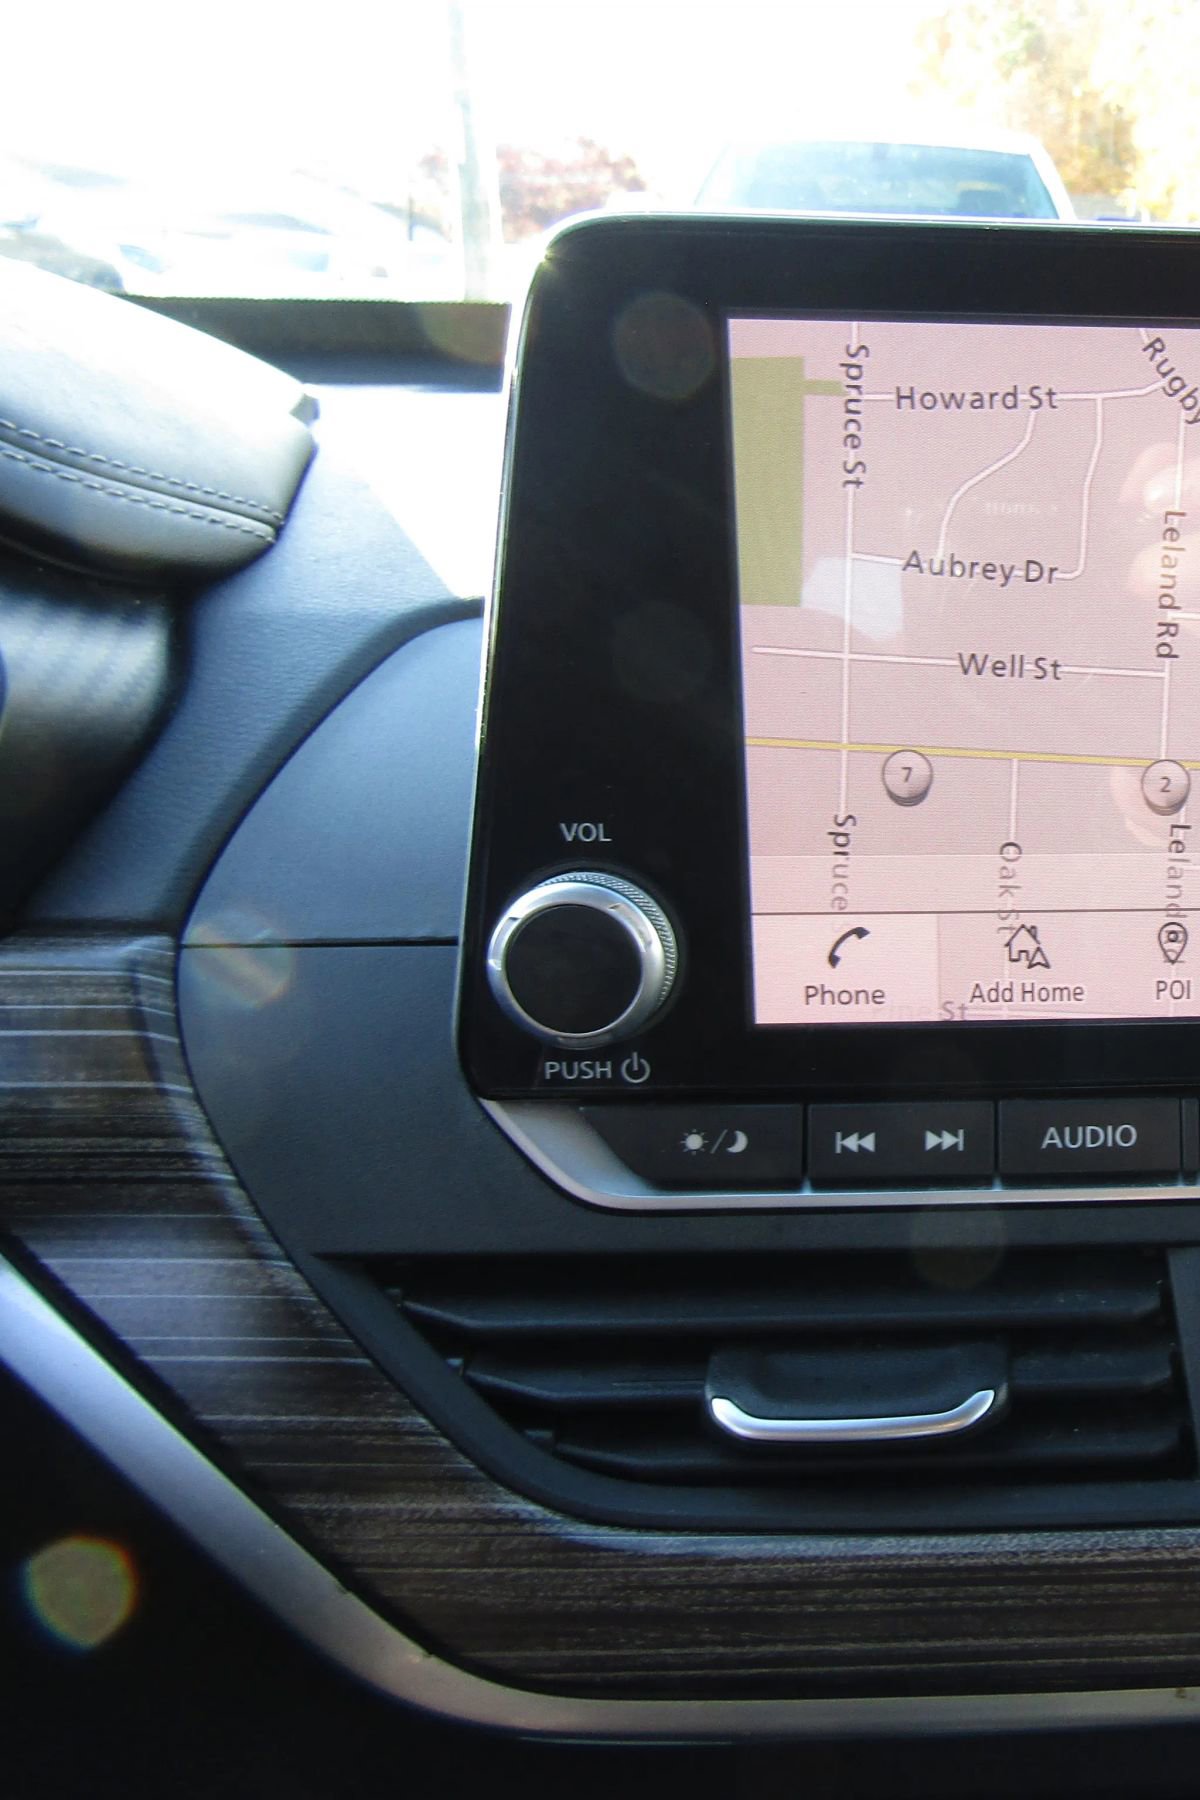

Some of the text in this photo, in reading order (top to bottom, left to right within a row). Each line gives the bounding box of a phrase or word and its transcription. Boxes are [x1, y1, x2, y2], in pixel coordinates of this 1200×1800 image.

[895, 384, 1058, 410] Howard St
[839, 343, 870, 489] Spruce St
[902, 550, 1059, 588] Aubrey Dr
[1155, 510, 1187, 659] Leland Rd
[958, 652, 1062, 681] Well St
[560, 822, 612, 842] VOL
[827, 814, 856, 911] Spruce
[998, 841, 1022, 898] Oak
[1164, 824, 1192, 919] Leland
[805, 984, 885, 1005] Phone
[970, 981, 1085, 1003] Add Home
[1156, 979, 1191, 1000] POI
[544, 1061, 612, 1080] PUSH
[1041, 1124, 1137, 1149] AUDIO
